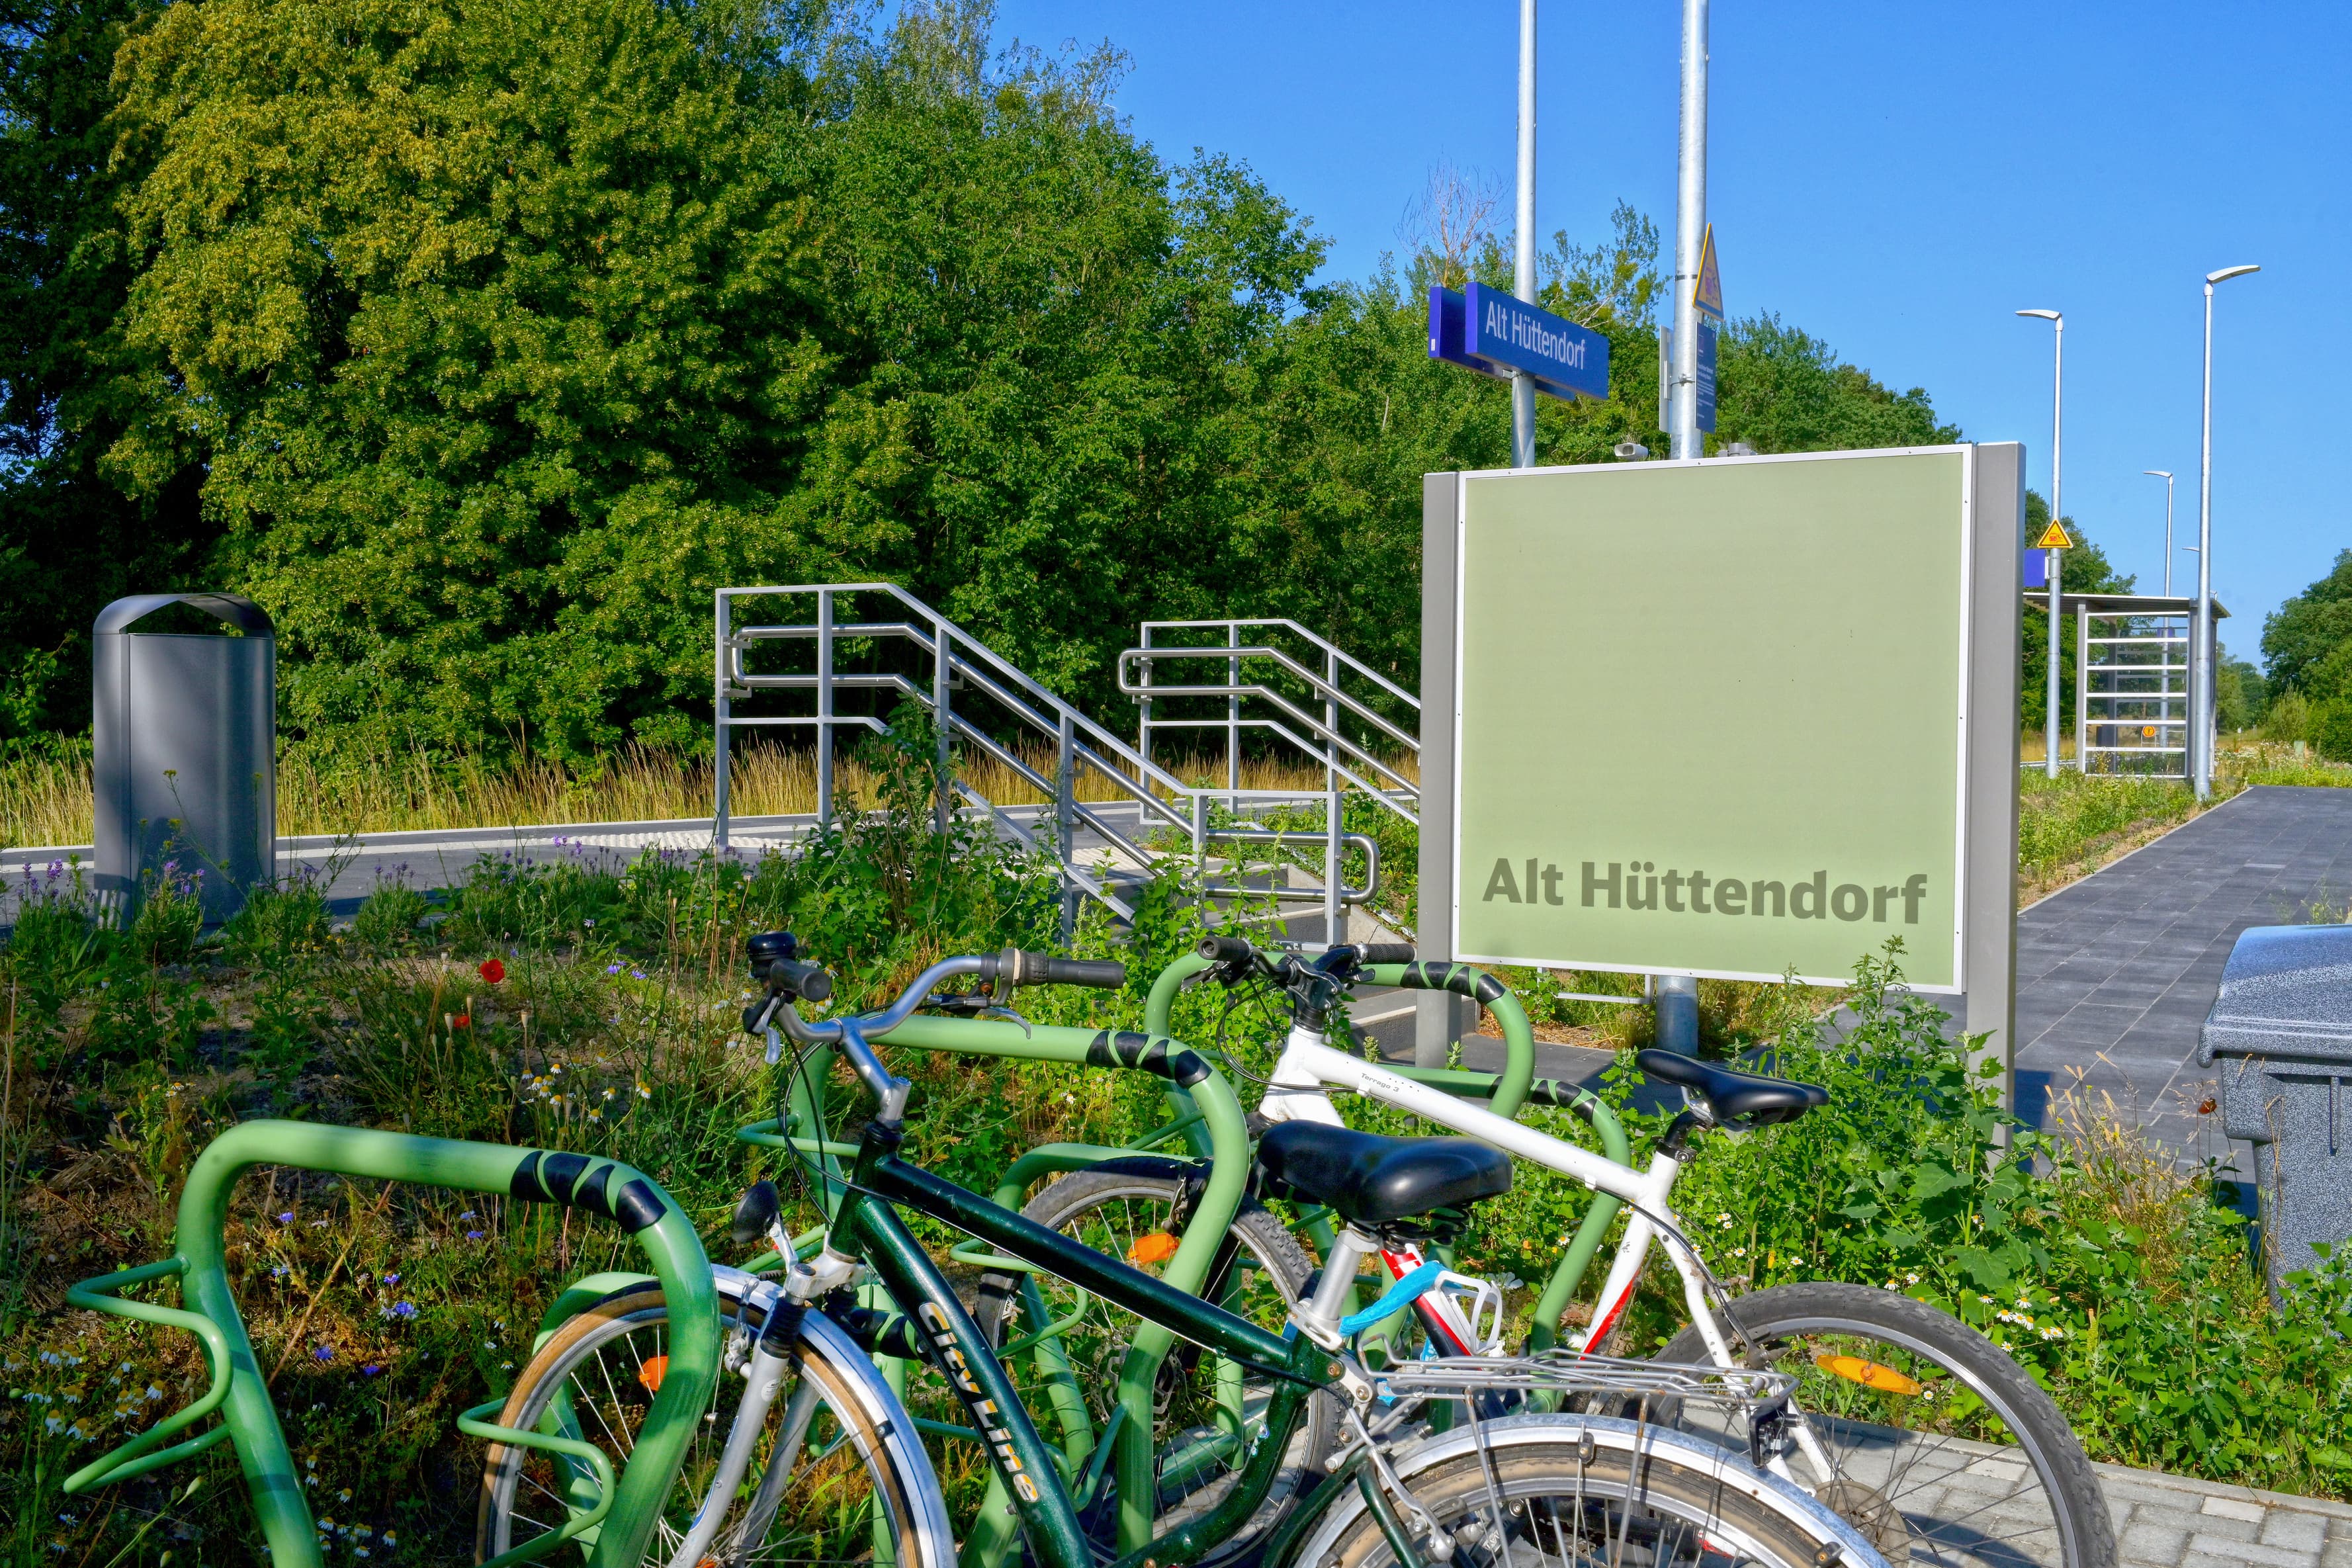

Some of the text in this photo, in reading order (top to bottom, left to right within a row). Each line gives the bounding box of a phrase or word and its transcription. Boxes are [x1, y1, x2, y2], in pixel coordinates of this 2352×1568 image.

[1485, 301, 1586, 370] Alt Hüttendorf
[1481, 857, 1928, 925] Alt Hüttendorf
[1361, 1072, 1391, 1089] Terrago
[918, 1302, 1039, 1503] City Line
